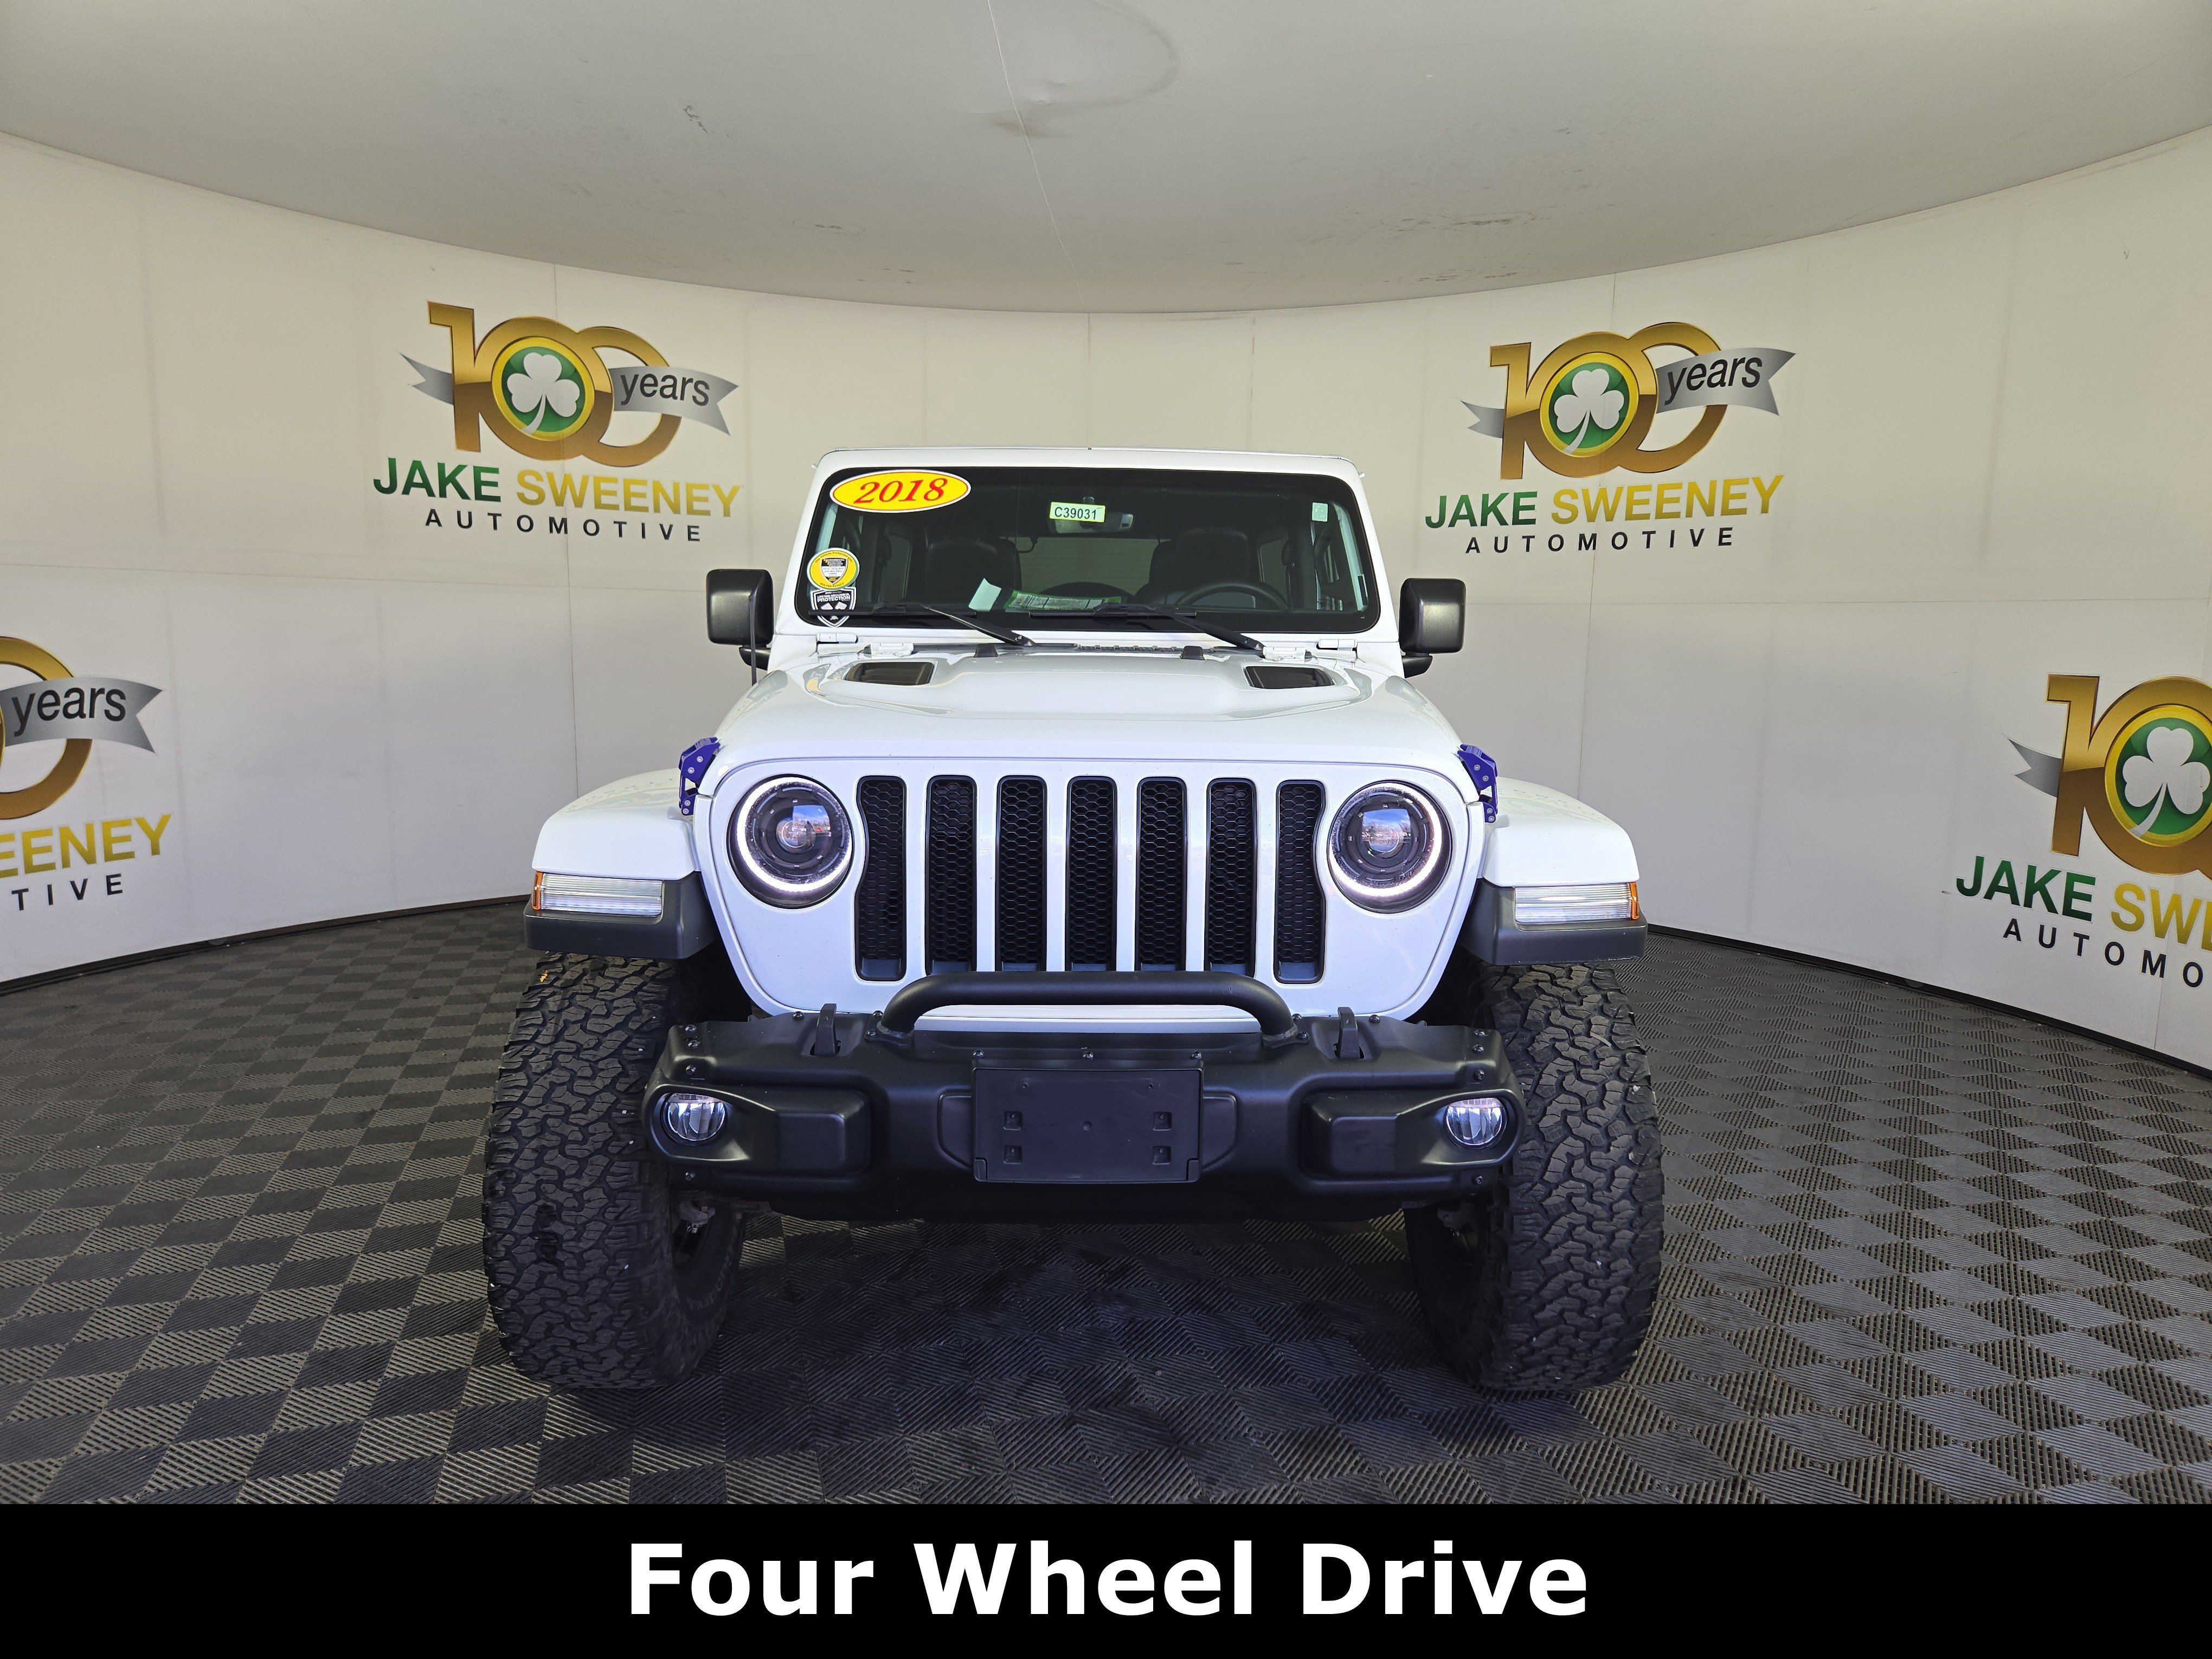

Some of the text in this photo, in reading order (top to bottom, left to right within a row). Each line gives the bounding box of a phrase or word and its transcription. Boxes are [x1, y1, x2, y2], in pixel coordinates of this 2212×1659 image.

[620, 373, 710, 406] years
[1664, 356, 1763, 406] years
[373, 457, 741, 517] JAKE SWEENEY
[853, 478, 949, 504] 2018
[1425, 474, 1784, 529] JAKE SWEENEY
[425, 508, 700, 542] AUTOMOTIVE
[1054, 506, 1097, 520] C39031
[1465, 527, 1734, 554] AUTOMOTIVE
[11, 686, 127, 737] years
[1956, 856, 2097, 922] JAKE
